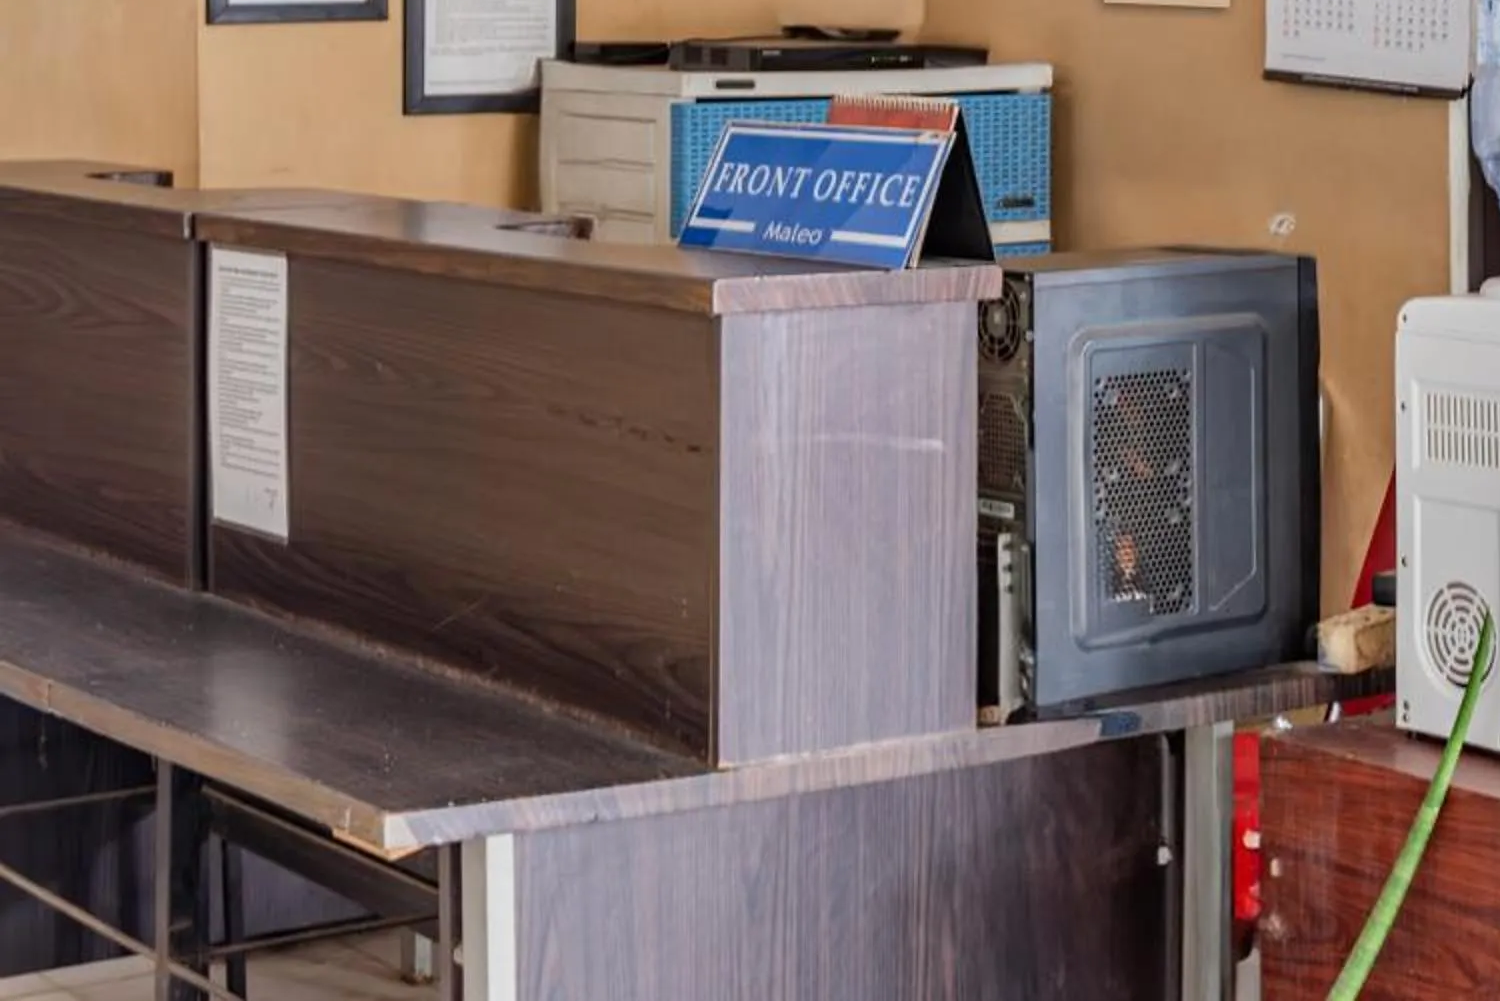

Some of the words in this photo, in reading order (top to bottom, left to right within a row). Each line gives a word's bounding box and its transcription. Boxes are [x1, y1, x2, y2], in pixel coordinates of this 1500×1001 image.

[712, 161, 813, 199] FRONT
[813, 168, 922, 209] OFFICE
[762, 220, 823, 246] Maleo
